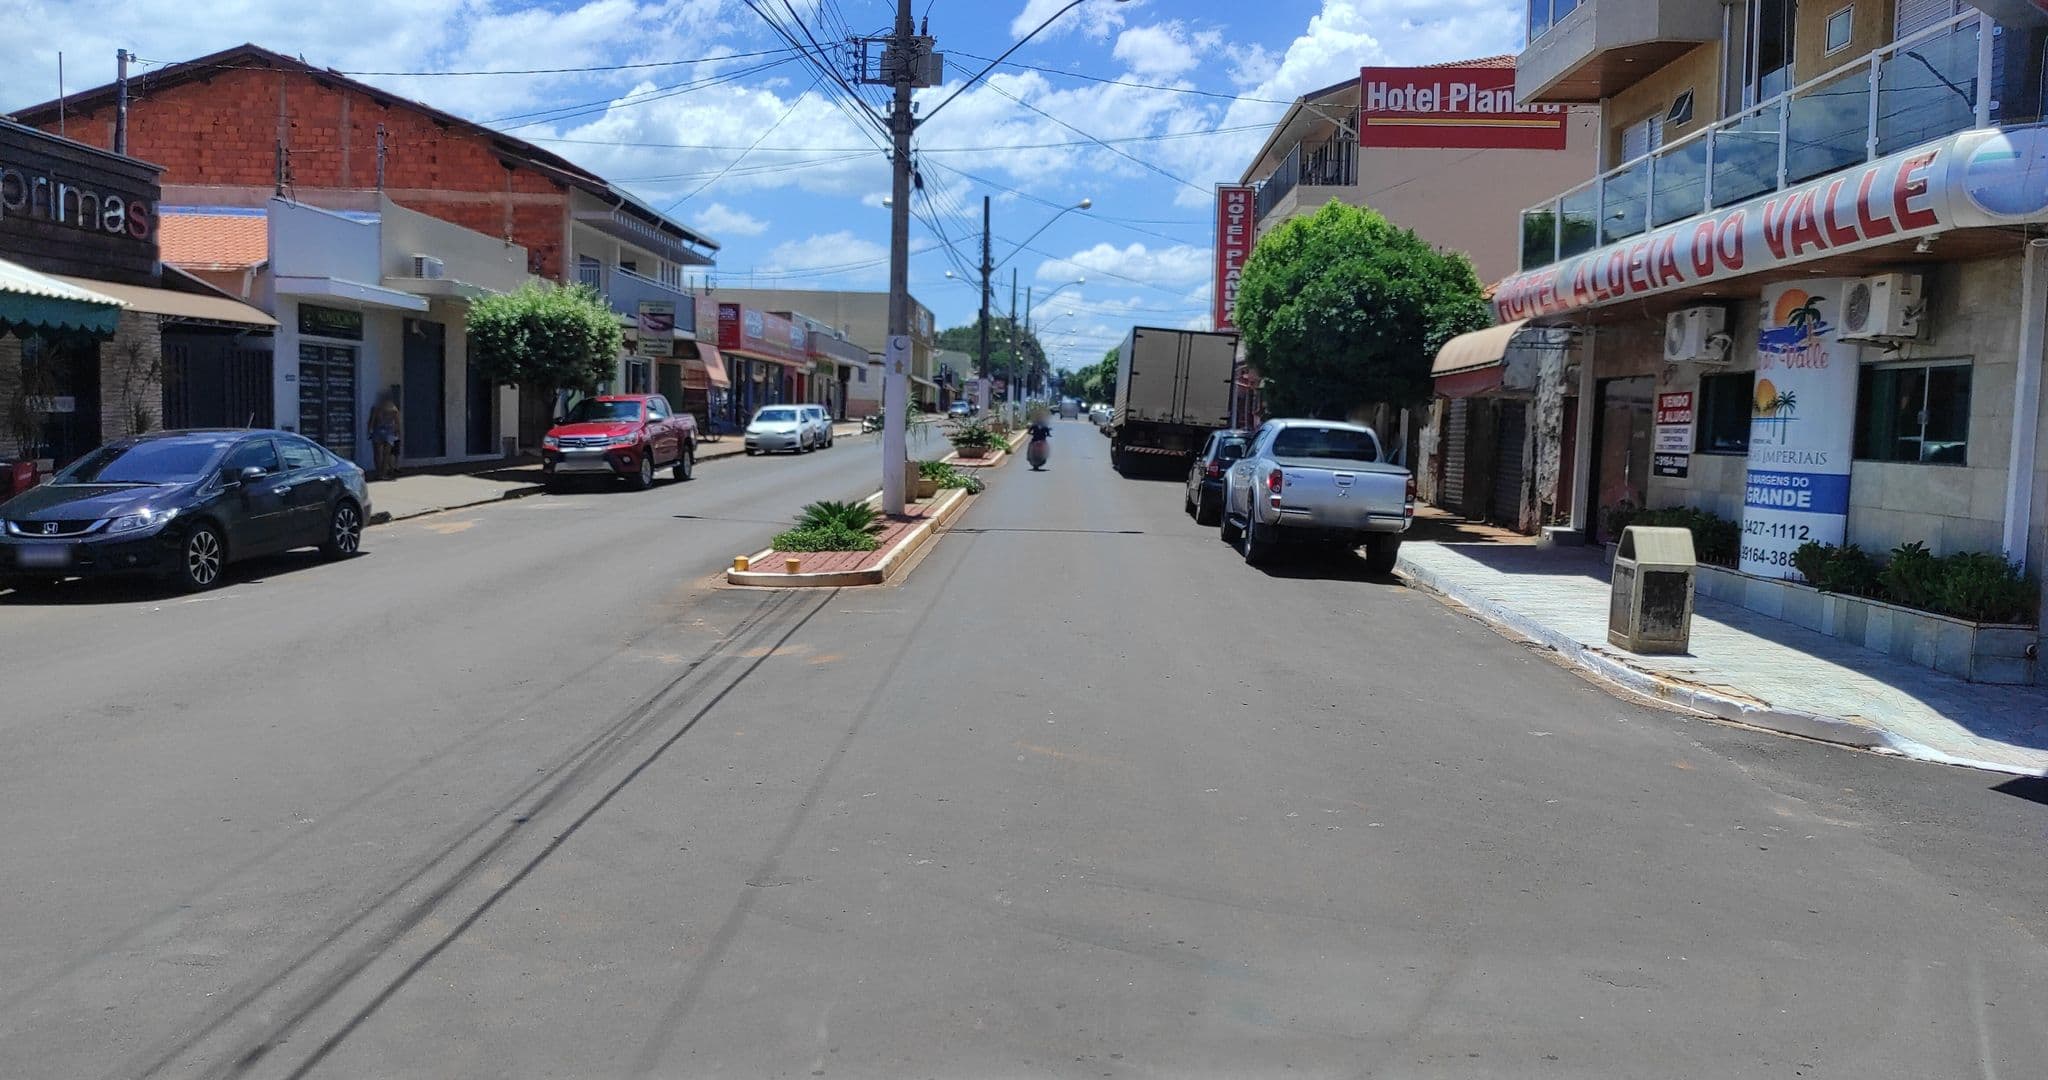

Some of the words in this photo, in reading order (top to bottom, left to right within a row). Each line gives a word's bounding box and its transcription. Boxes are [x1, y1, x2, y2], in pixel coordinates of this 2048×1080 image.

[1367, 81, 1441, 112] Hotel
[1450, 82, 1561, 114] Plan
[0, 166, 149, 240] primas
[1226, 192, 1245, 245] HOTEL
[1496, 268, 1569, 323] HOTEL
[1573, 231, 1685, 304] ALDEIA
[1691, 210, 1746, 278] DO
[1763, 148, 1940, 260] VALLE
[1762, 450, 1828, 466] IMPERIAIS
[1746, 486, 1812, 508] GRANDE
[1792, 477, 1810, 488] DO
